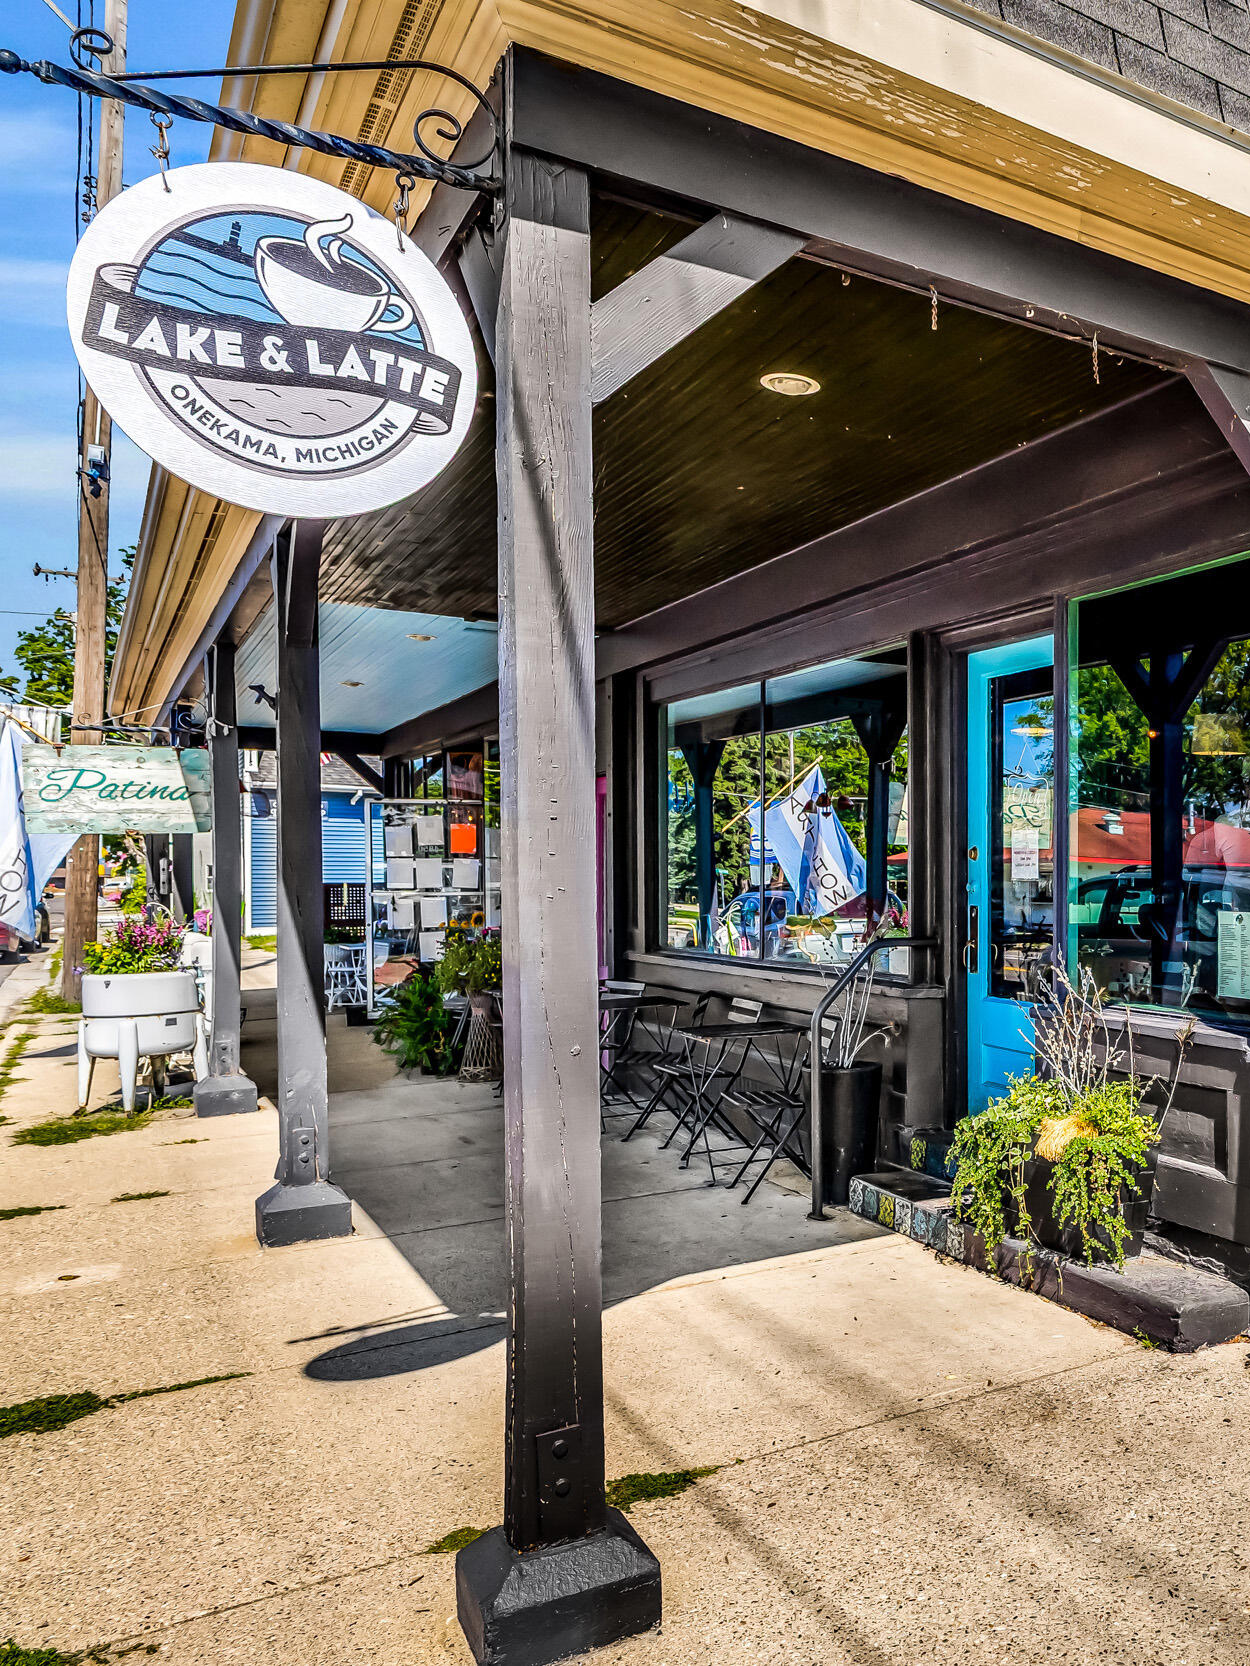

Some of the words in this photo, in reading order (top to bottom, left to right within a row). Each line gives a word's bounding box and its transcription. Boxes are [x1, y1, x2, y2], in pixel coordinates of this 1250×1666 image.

[98, 301, 245, 368] LAKE
[259, 335, 294, 373] &
[305, 338, 450, 406] LATTE
[170, 384, 287, 463] ONEKAMA,
[295, 417, 399, 464] MICHIGAN
[39, 768, 193, 802] Patina
